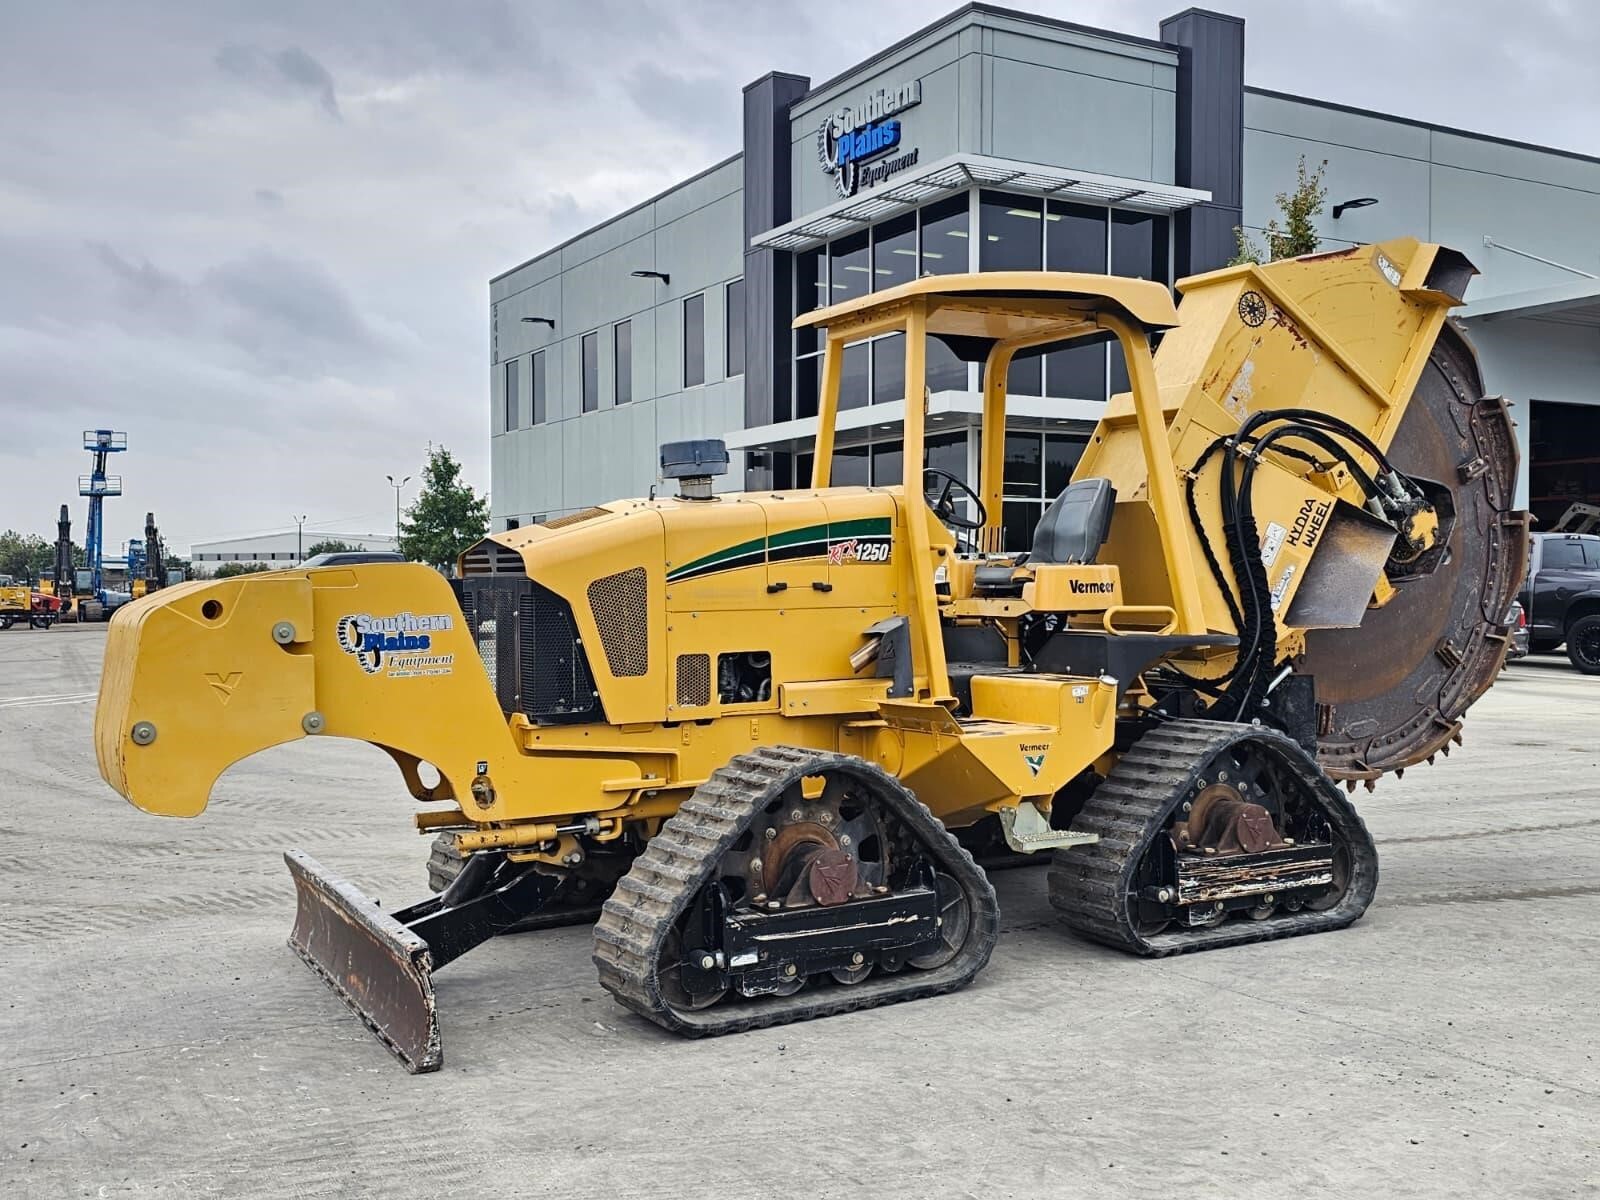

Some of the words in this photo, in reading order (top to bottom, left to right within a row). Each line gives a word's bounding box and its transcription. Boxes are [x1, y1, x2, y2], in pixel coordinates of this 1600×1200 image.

[833, 80, 921, 137] Southern
[838, 119, 900, 167] Plains
[860, 148, 919, 187] Equipment
[1286, 499, 1317, 547] HYDRA
[1302, 501, 1331, 549] WHEEL
[829, 540, 857, 565] RTX
[856, 543, 889, 561] 1250
[1069, 579, 1115, 593] Vermeer
[356, 613, 452, 633] Southern
[364, 631, 430, 652] Plains
[389, 655, 453, 668] Equipment
[1019, 743, 1050, 752] Vermeer
